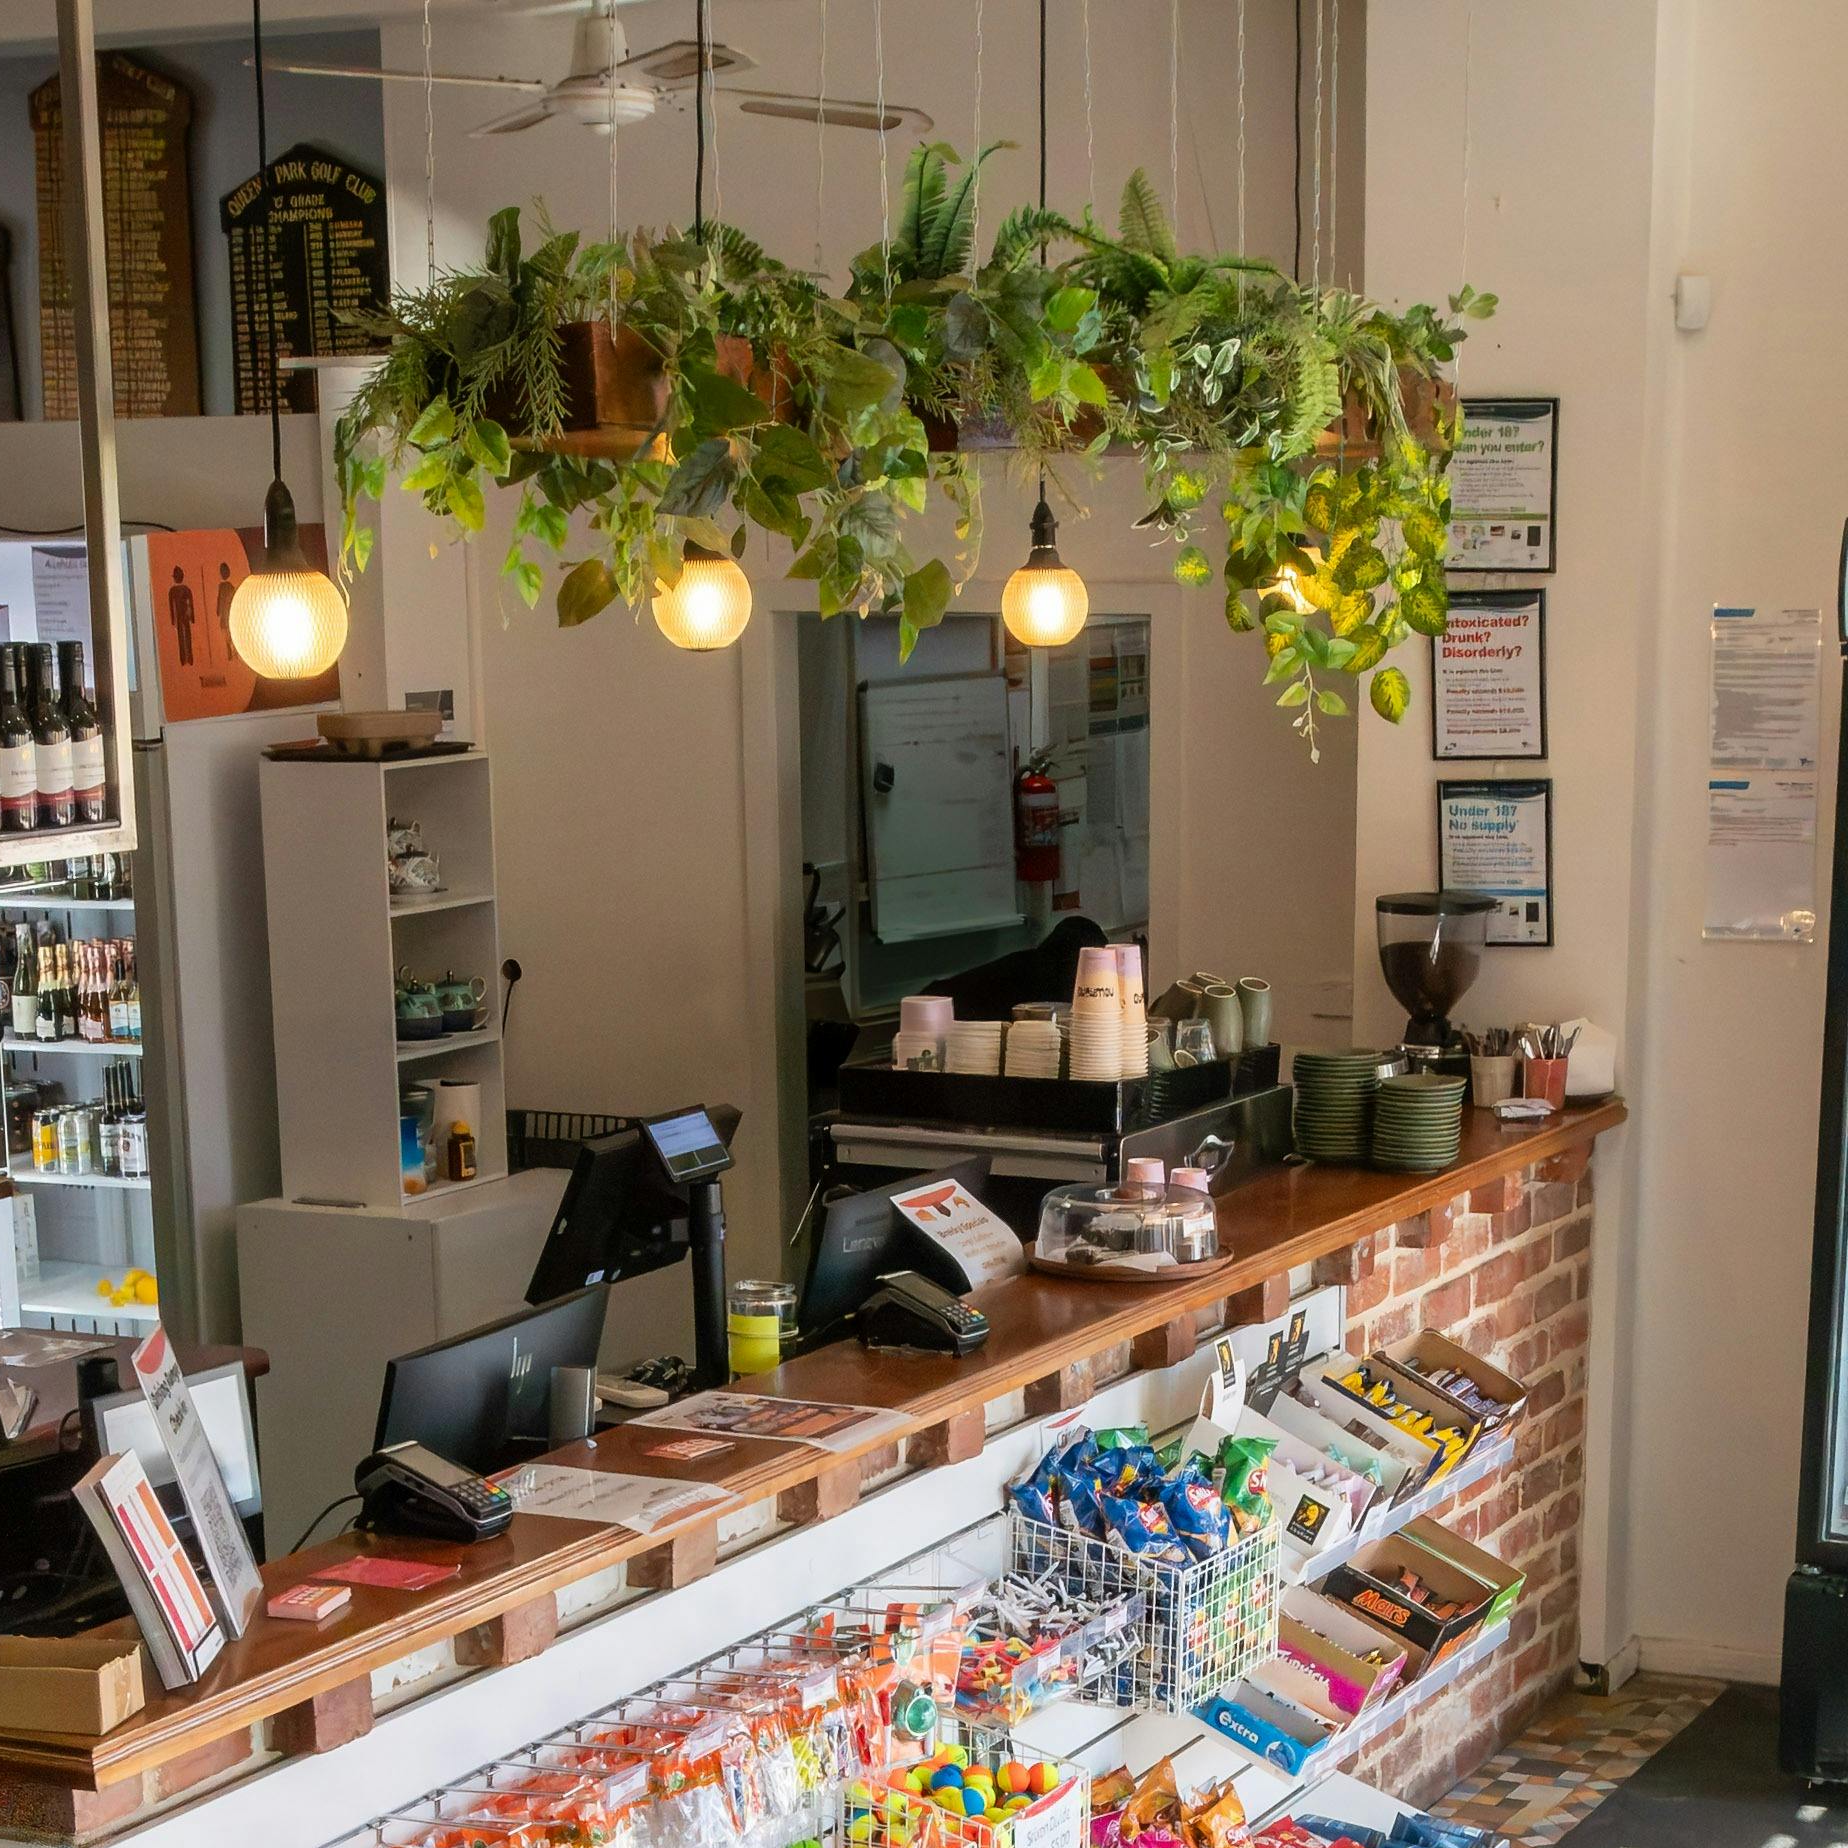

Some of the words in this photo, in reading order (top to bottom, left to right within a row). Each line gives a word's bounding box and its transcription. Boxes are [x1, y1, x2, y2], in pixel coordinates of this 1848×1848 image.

[274, 161, 307, 184] PARK
[311, 161, 342, 185] GOLF
[345, 174, 377, 204] CLUB
[1463, 426, 1492, 438] nder
[1443, 616, 1529, 628] ntoxicated?
[1442, 631, 1491, 644] Drunk?
[1442, 646, 1522, 660] Disorderly?
[1449, 805, 1489, 817] Under
[1352, 1589, 1411, 1628] Mars
[1218, 1709, 1260, 1745] extra
